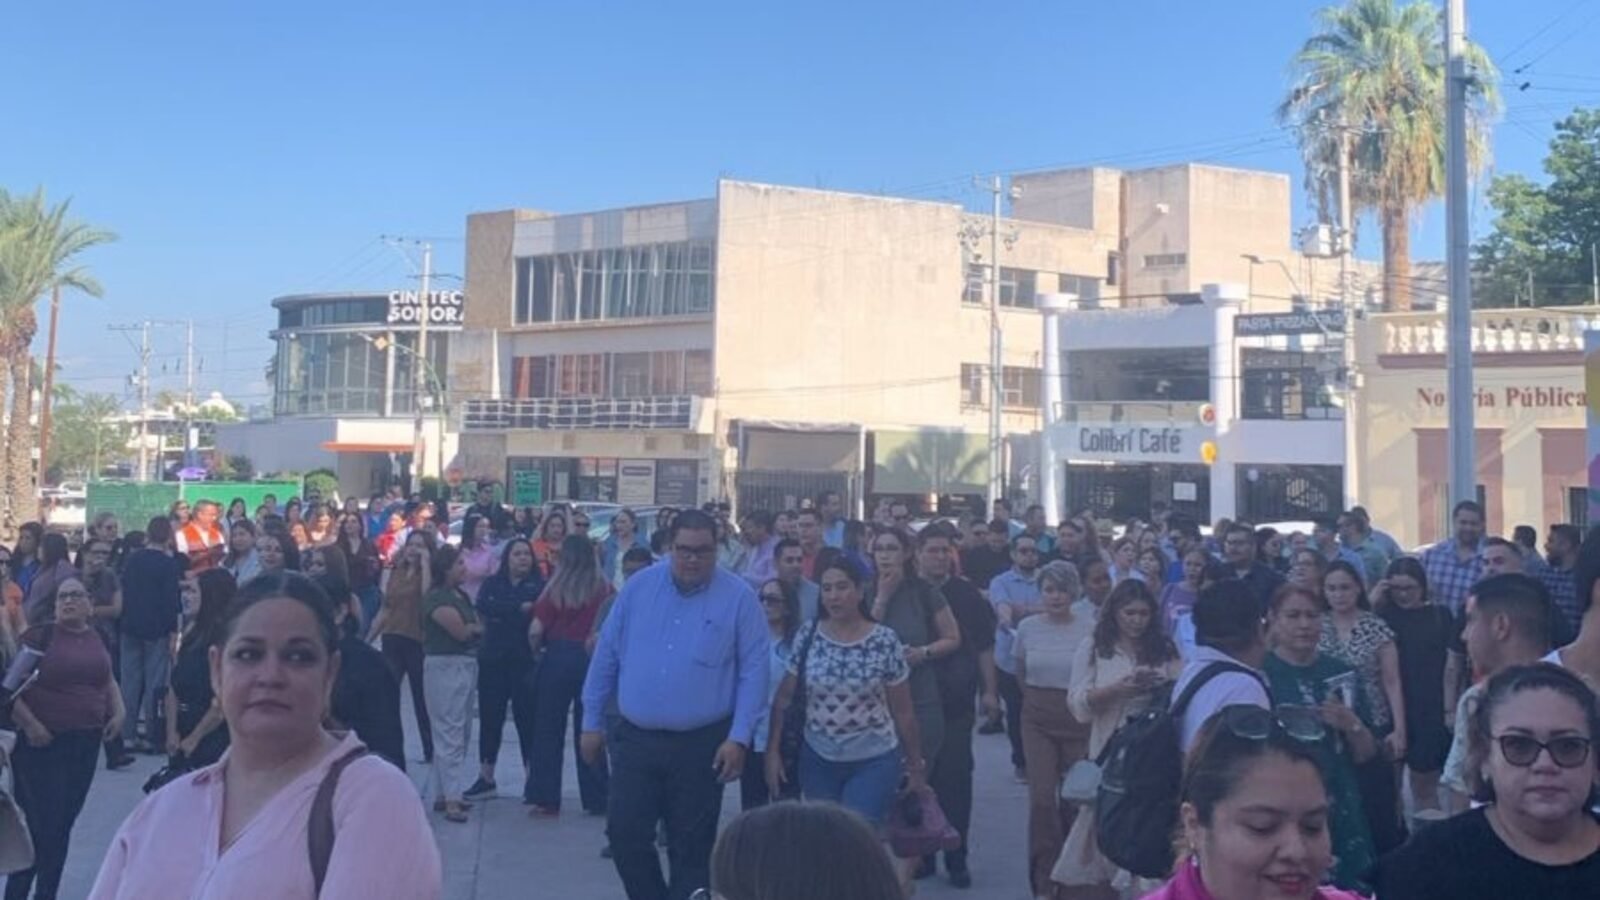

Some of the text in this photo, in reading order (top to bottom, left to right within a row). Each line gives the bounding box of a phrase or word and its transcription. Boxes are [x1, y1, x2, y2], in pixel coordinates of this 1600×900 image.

[389, 290, 464, 305] CINTEC
[1506, 386, 1588, 408] Pública
[1080, 427, 1182, 453] Colibrí Café
